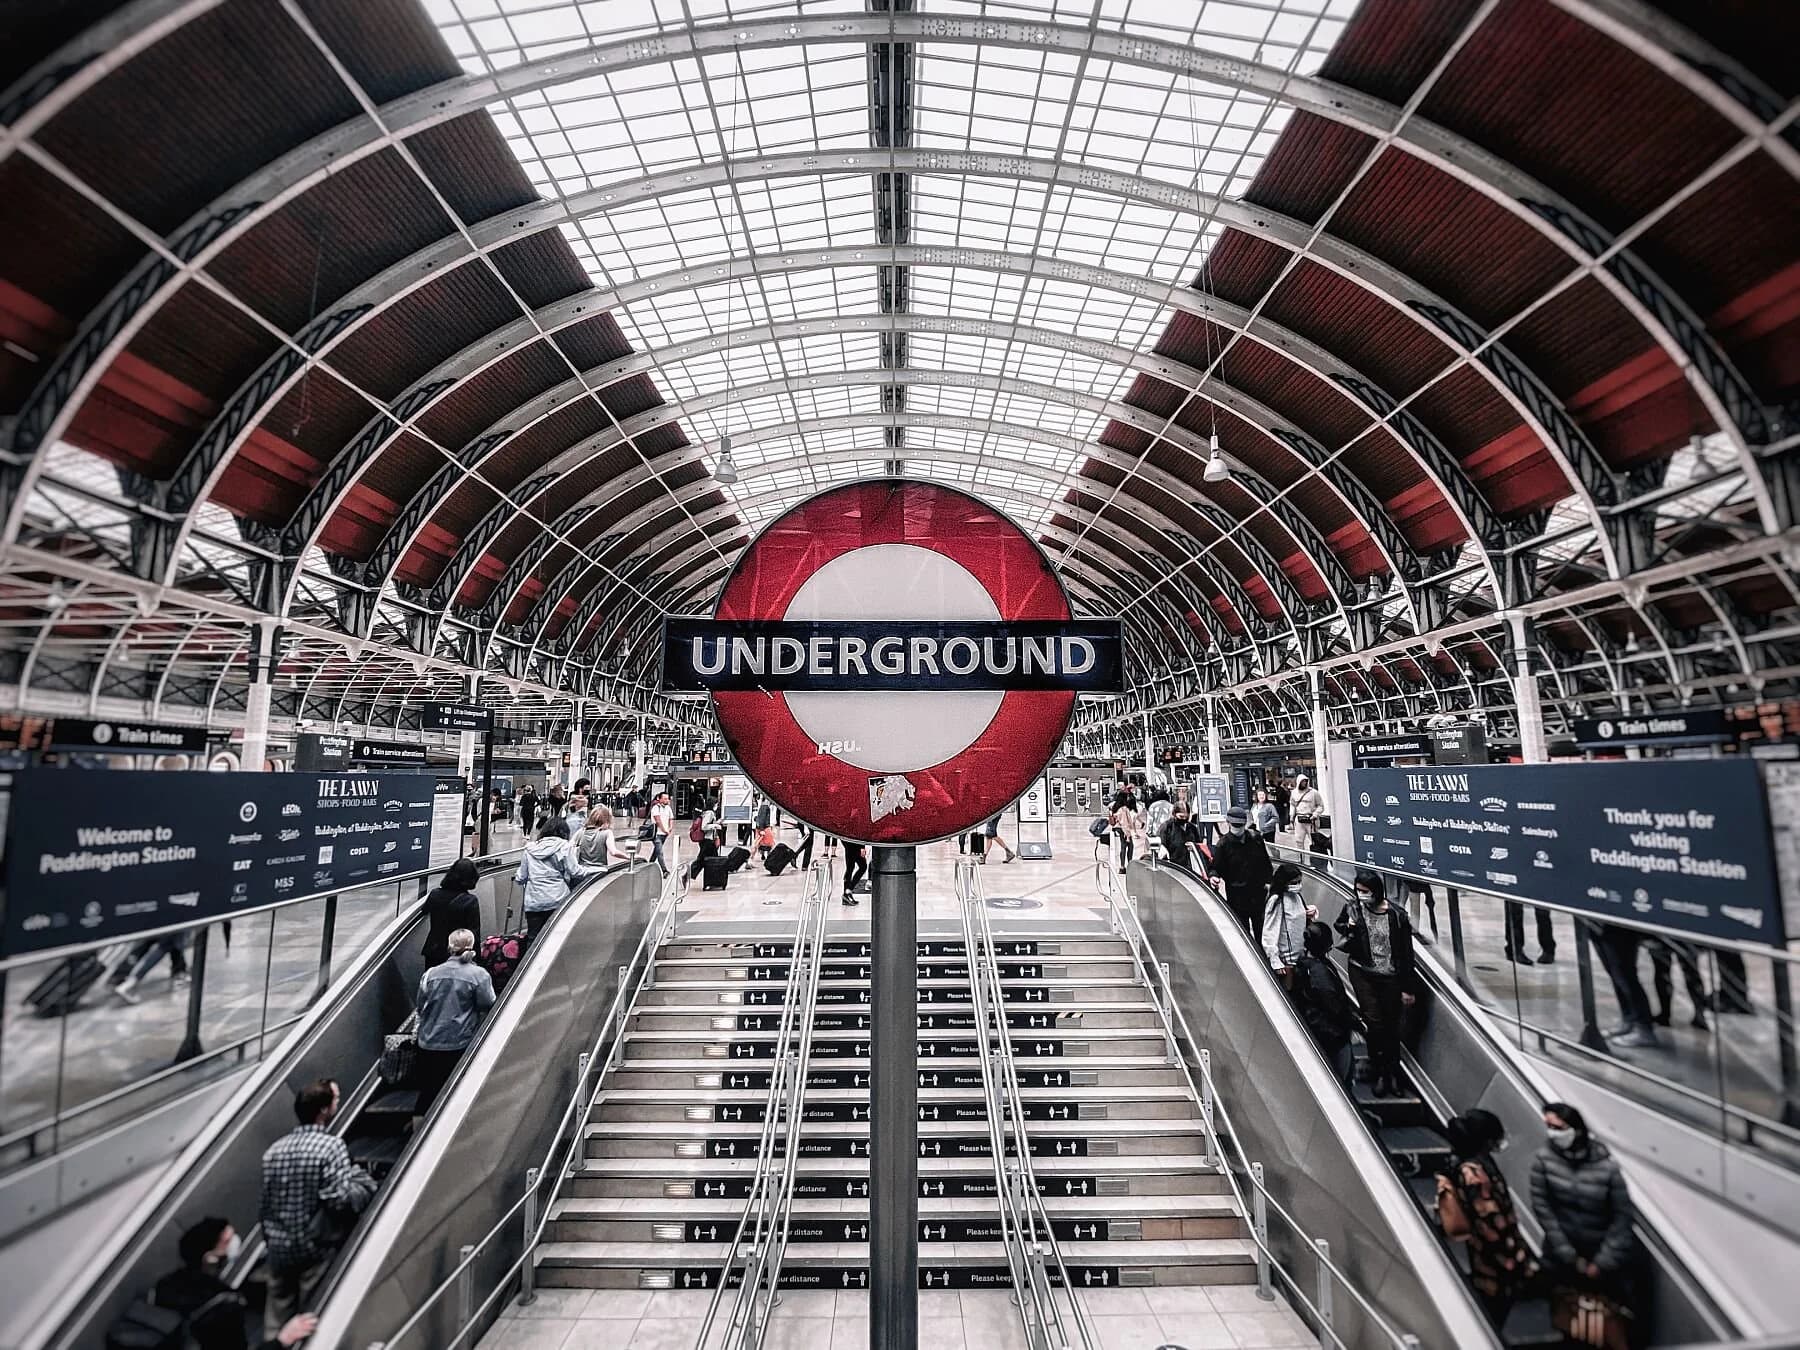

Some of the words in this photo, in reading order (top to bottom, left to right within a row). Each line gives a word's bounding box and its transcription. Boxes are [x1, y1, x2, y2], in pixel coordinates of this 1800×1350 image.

[692, 636, 1096, 675] UNDERGROUND
[1436, 730, 1463, 740] Paddington
[1616, 720, 1648, 735] Train
[1649, 718, 1687, 734] times
[117, 727, 149, 744] Train
[150, 730, 184, 745] times
[1441, 741, 1460, 750] Station
[318, 779, 340, 797] THE
[340, 779, 379, 797] LAWN
[1406, 774, 1426, 791] THE
[1426, 774, 1469, 791] LAWN
[317, 799, 340, 808] SHOPS
[1409, 793, 1430, 801] SHOPS
[1452, 794, 1471, 803] BARS
[1603, 807, 1653, 826] Thank
[1654, 813, 1686, 830] you
[1687, 809, 1715, 829] for
[77, 826, 153, 847] Welcome
[154, 825, 173, 841] to
[1630, 831, 1690, 855] visiting
[350, 847, 369, 856] COSTA
[1449, 845, 1472, 855] COSTA
[39, 851, 139, 875] Paddington
[141, 845, 197, 864] Station
[1590, 848, 1679, 873] Paddington
[1680, 855, 1747, 880] Station
[274, 877, 295, 889] M&S
